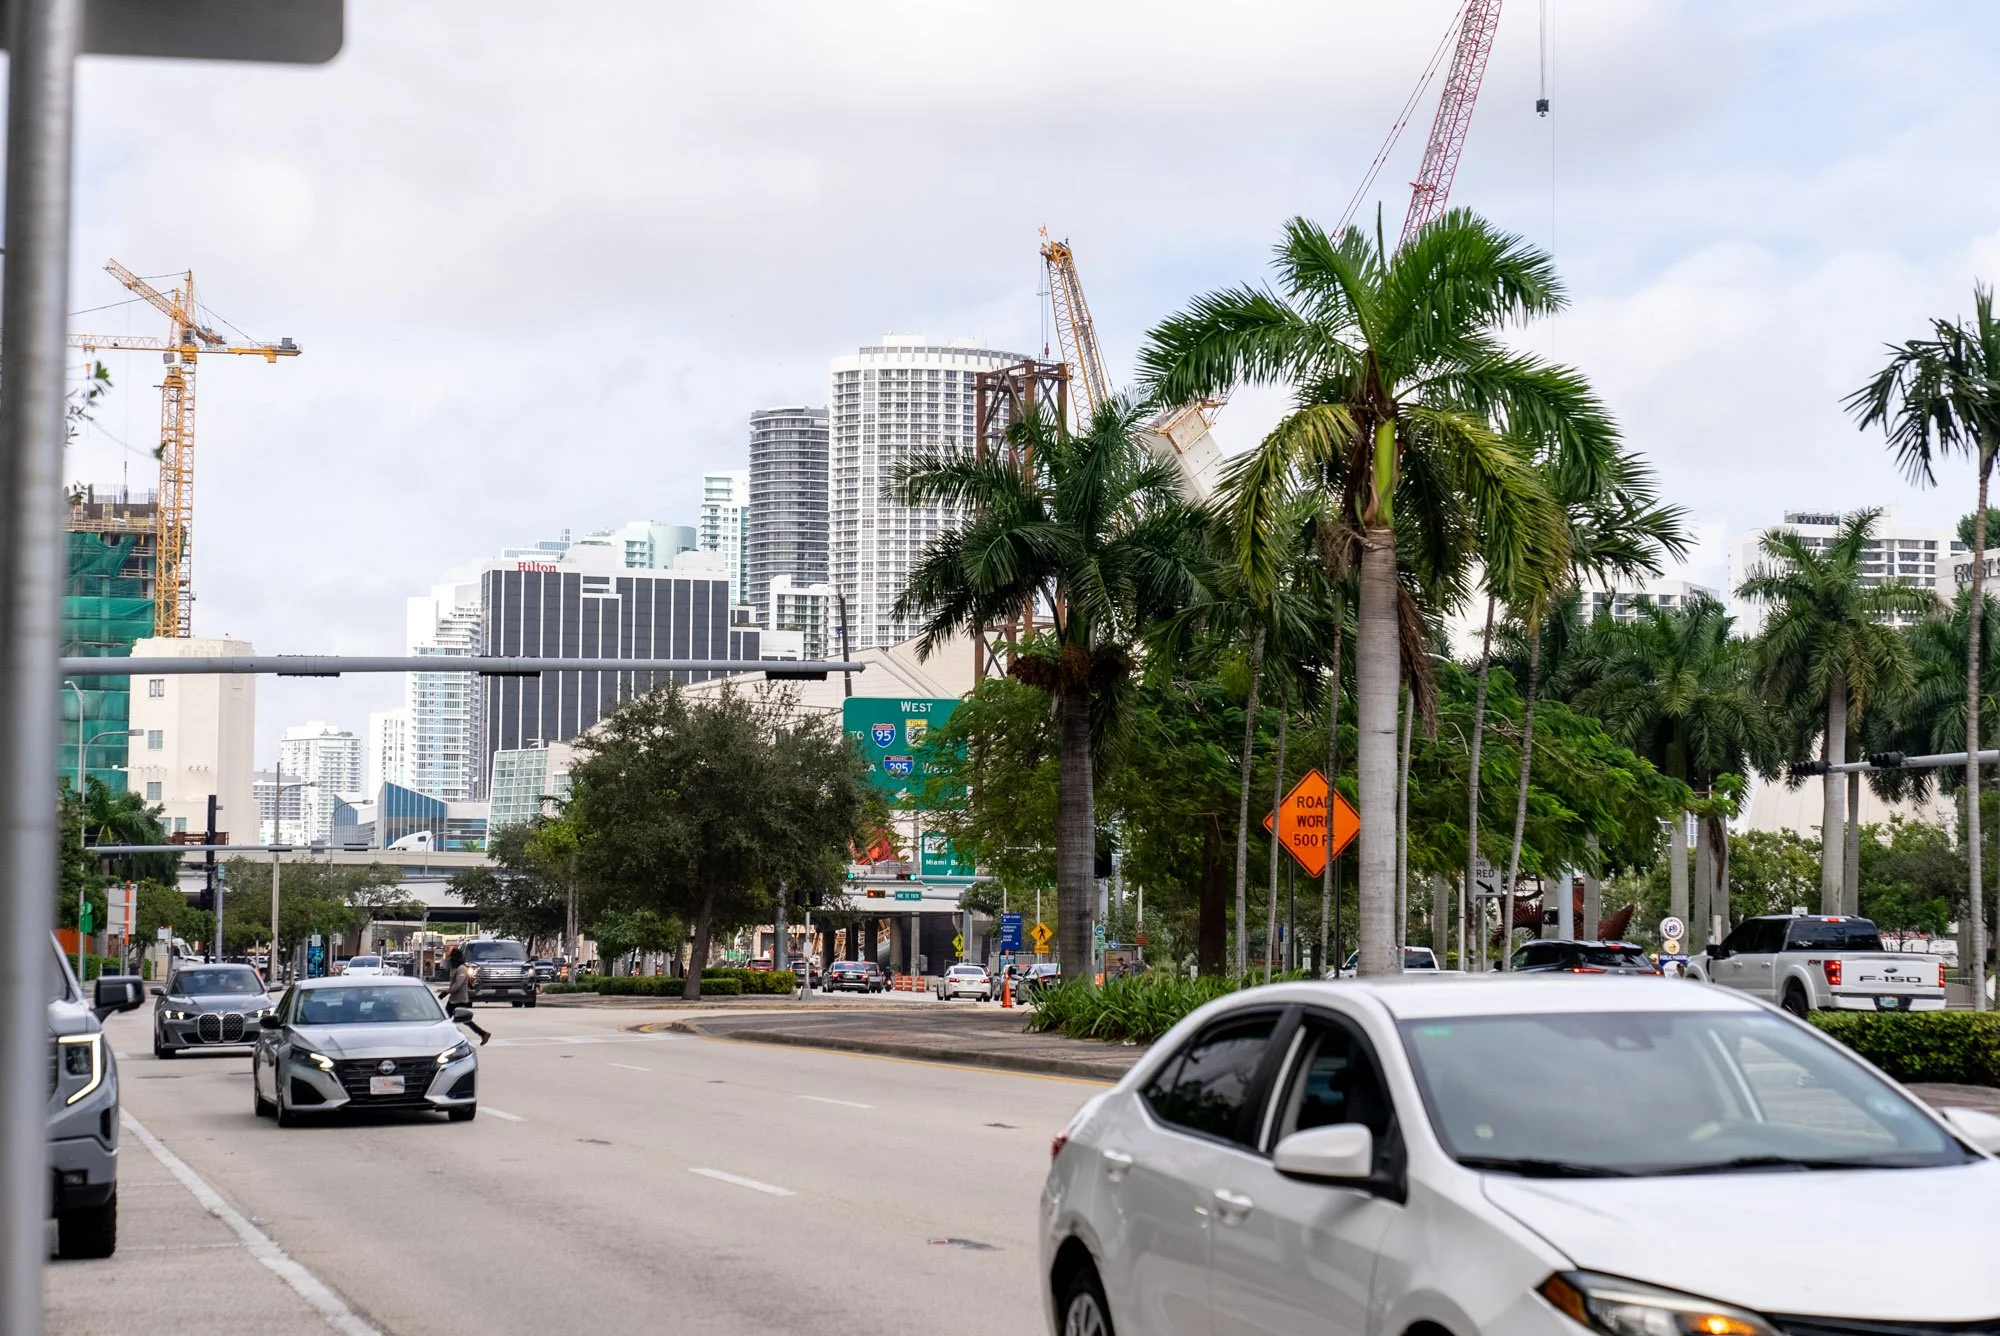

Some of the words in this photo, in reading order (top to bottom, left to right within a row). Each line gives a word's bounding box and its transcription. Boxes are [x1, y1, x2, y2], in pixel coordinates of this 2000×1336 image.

[517, 561, 557, 573] Hilton
[900, 701, 933, 712] WEST
[876, 730, 891, 742] 95
[1294, 834, 1318, 846] 500
[1476, 869, 1494, 878] RED
[1859, 975, 1922, 983] F-150
